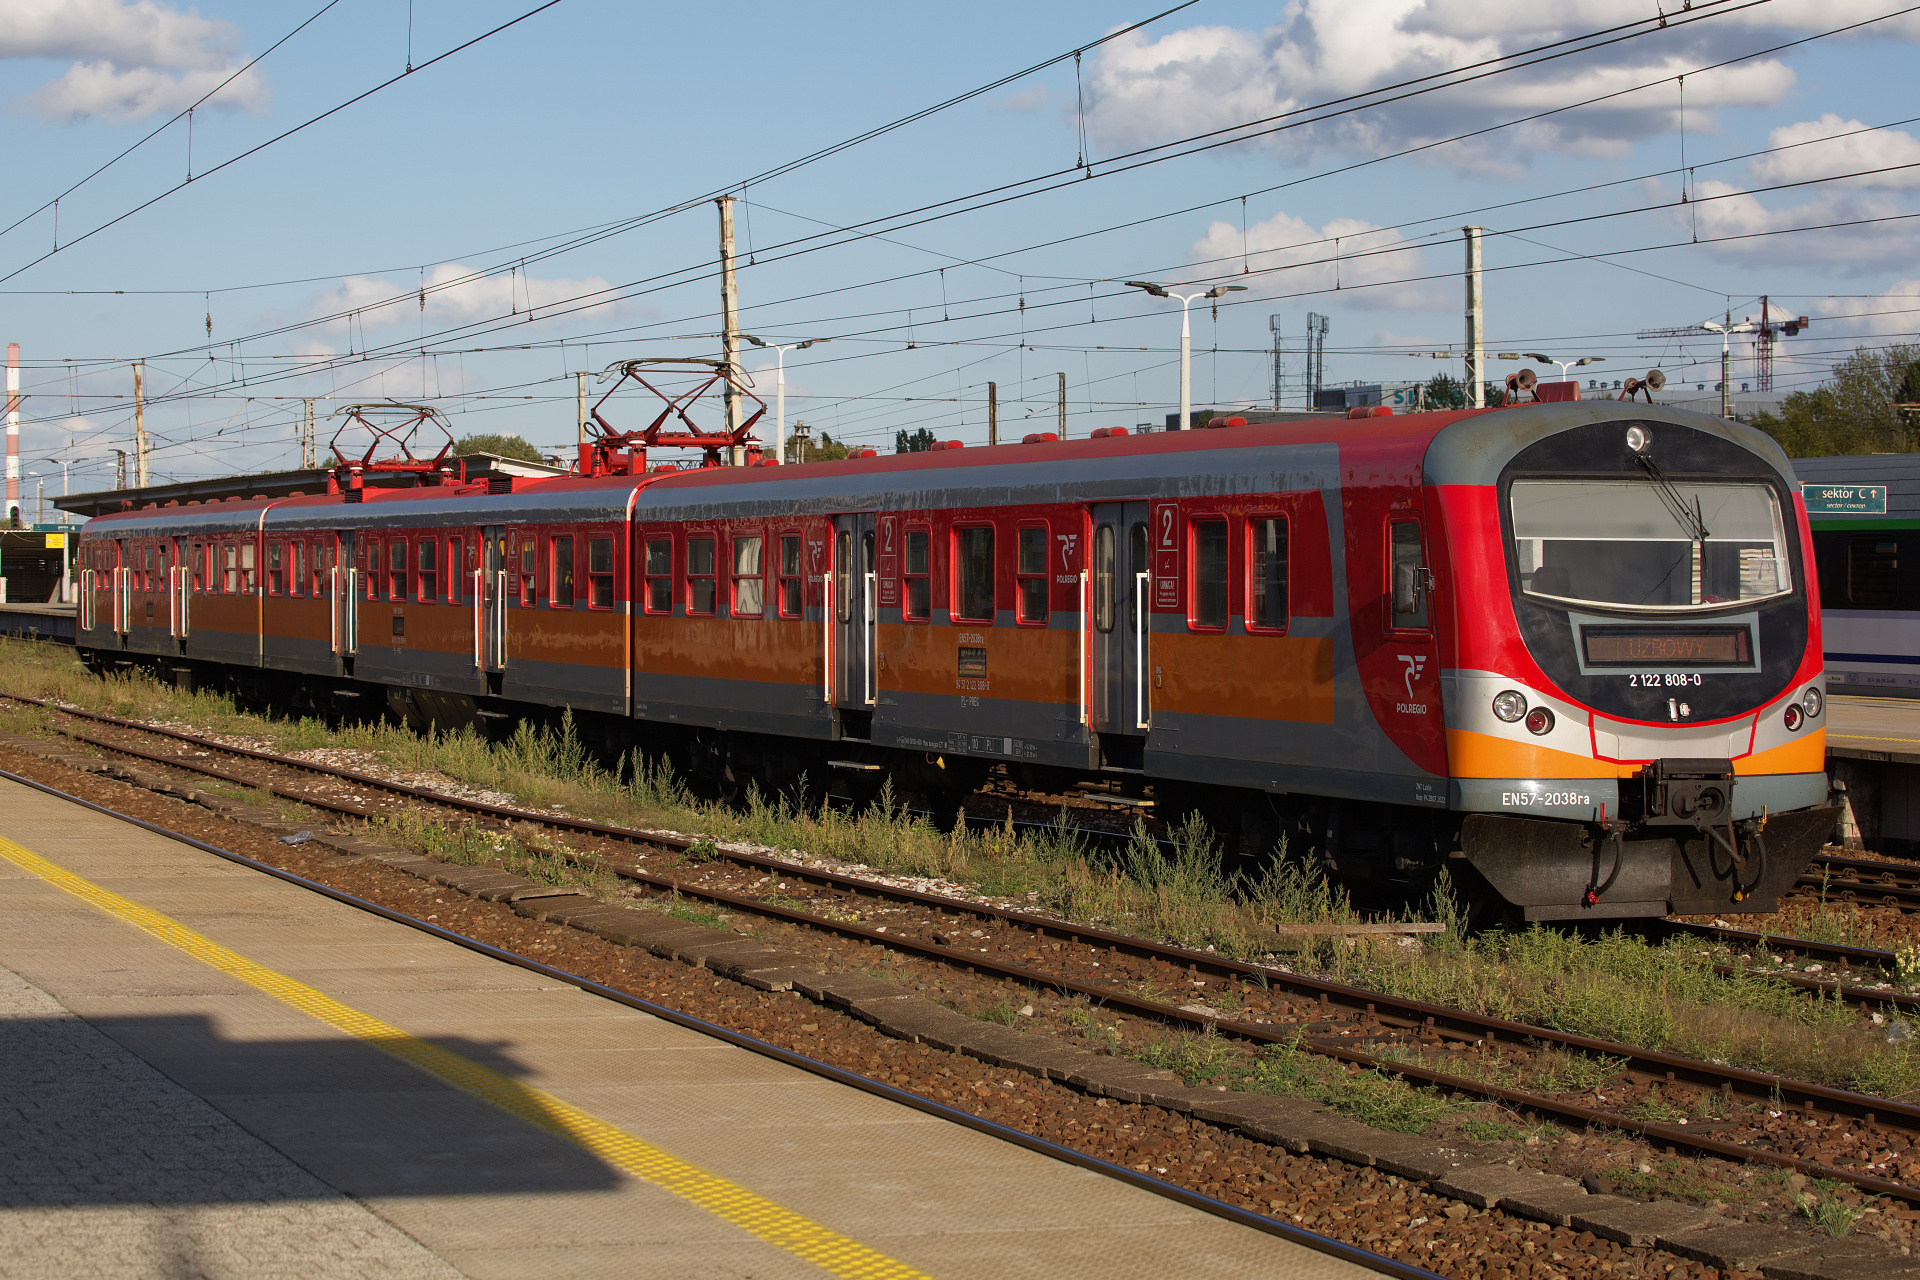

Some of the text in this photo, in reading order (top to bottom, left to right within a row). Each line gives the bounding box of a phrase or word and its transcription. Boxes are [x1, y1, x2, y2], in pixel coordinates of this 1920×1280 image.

[1822, 487, 1866, 499] sektor C
[1163, 509, 1172, 546] 2
[511, 531, 516, 555] 2
[885, 521, 892, 552] 2
[1056, 574, 1078, 584] POLREGIO
[959, 632, 984, 644] EN57-2038ra
[1629, 673, 1702, 687] 2 122 808-0
[1396, 702, 1427, 715] POLREGIO
[1502, 792, 1590, 806] EN57-2038ra
